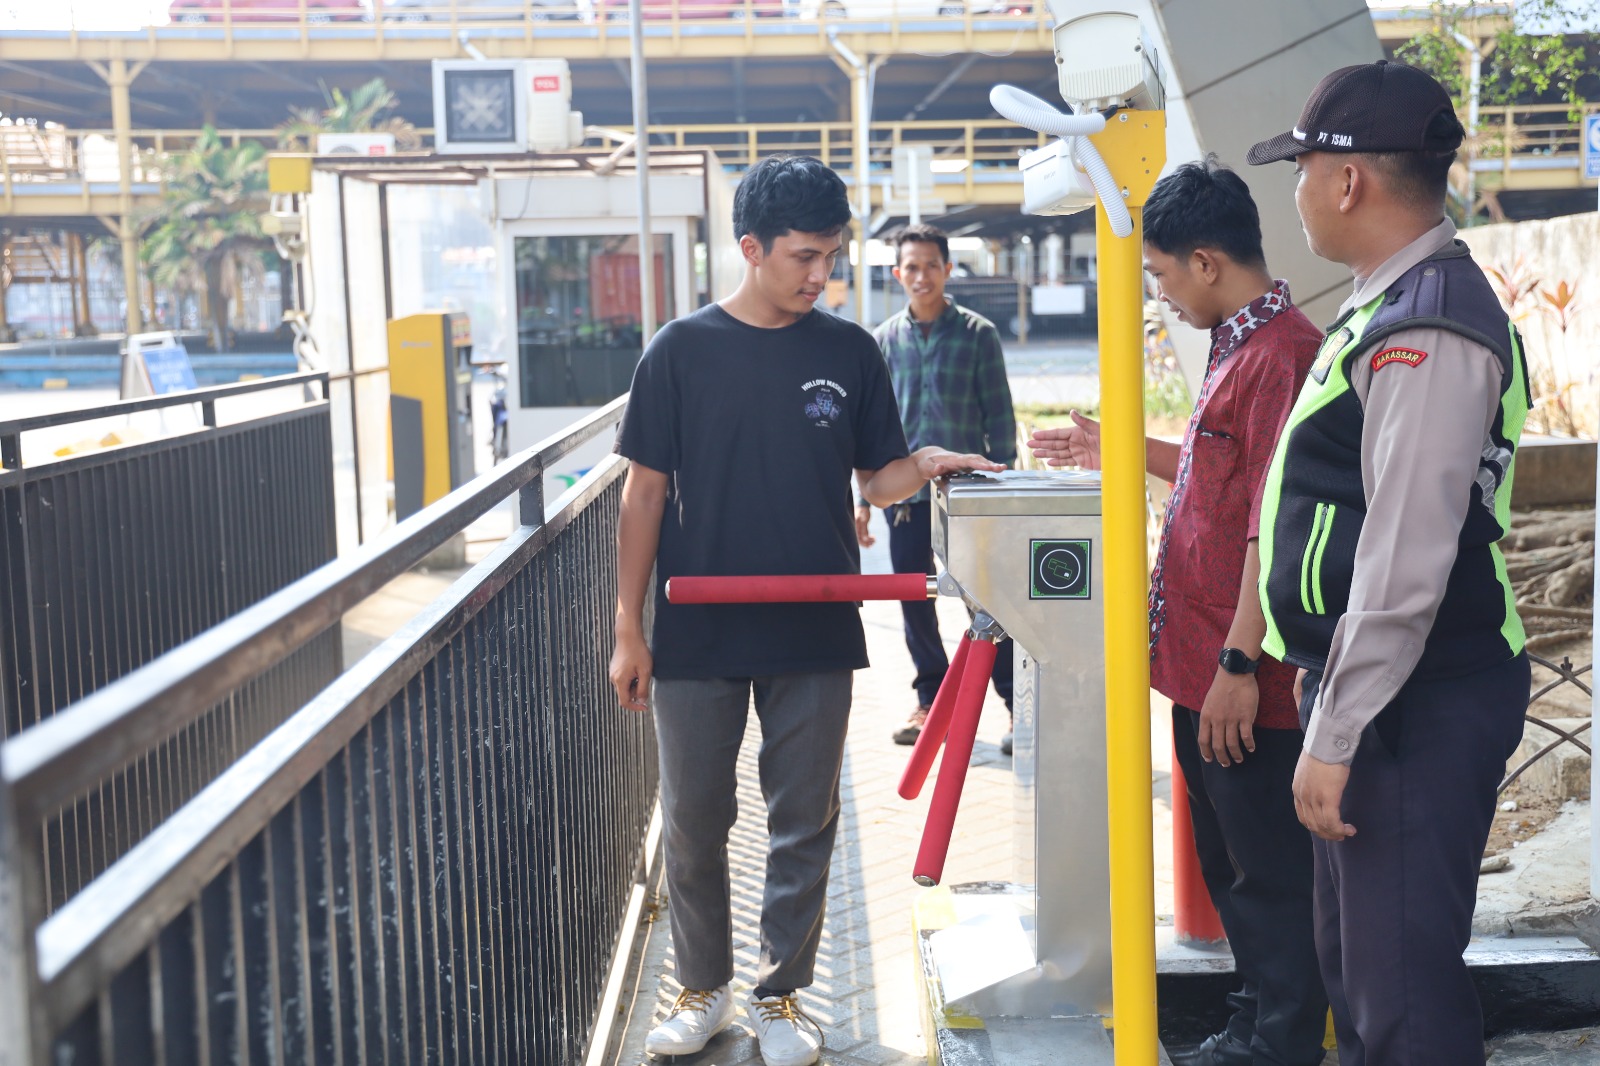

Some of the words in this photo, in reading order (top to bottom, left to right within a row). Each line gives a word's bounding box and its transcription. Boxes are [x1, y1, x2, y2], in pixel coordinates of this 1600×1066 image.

[535, 79, 556, 89] TCL
[1317, 132, 1328, 143] PT
[1331, 134, 1352, 147] ISMA
[1376, 351, 1419, 367] MAKASSAR
[801, 379, 825, 391] HOLLOW
[826, 380, 847, 397] MASKED
